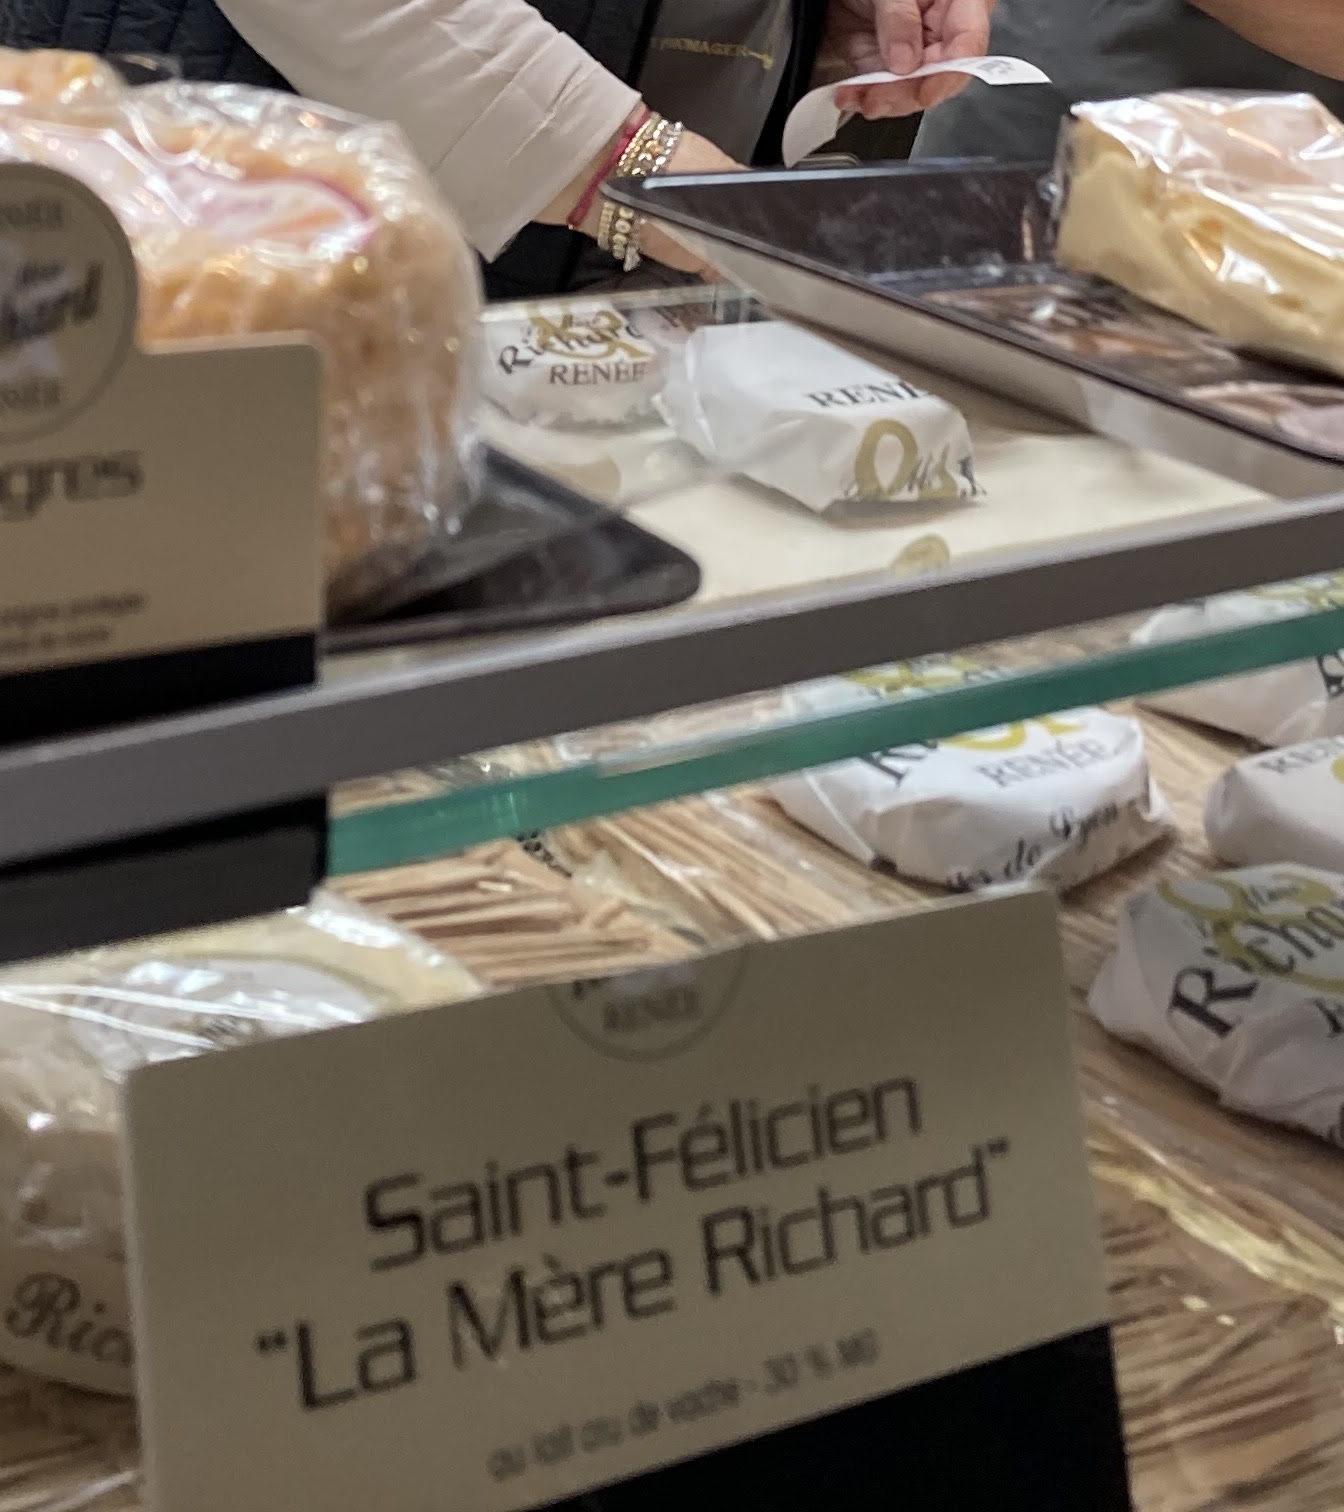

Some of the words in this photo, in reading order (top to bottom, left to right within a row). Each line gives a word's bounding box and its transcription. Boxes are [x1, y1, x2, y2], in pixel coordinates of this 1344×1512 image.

[362, 1074, 923, 1272] Saint-Félicien
[4, 1270, 137, 1371] Ric
[256, 1317, 416, 1413] "La
[446, 1242, 677, 1373] Mère
[701, 1136, 1011, 1299] Richard"
